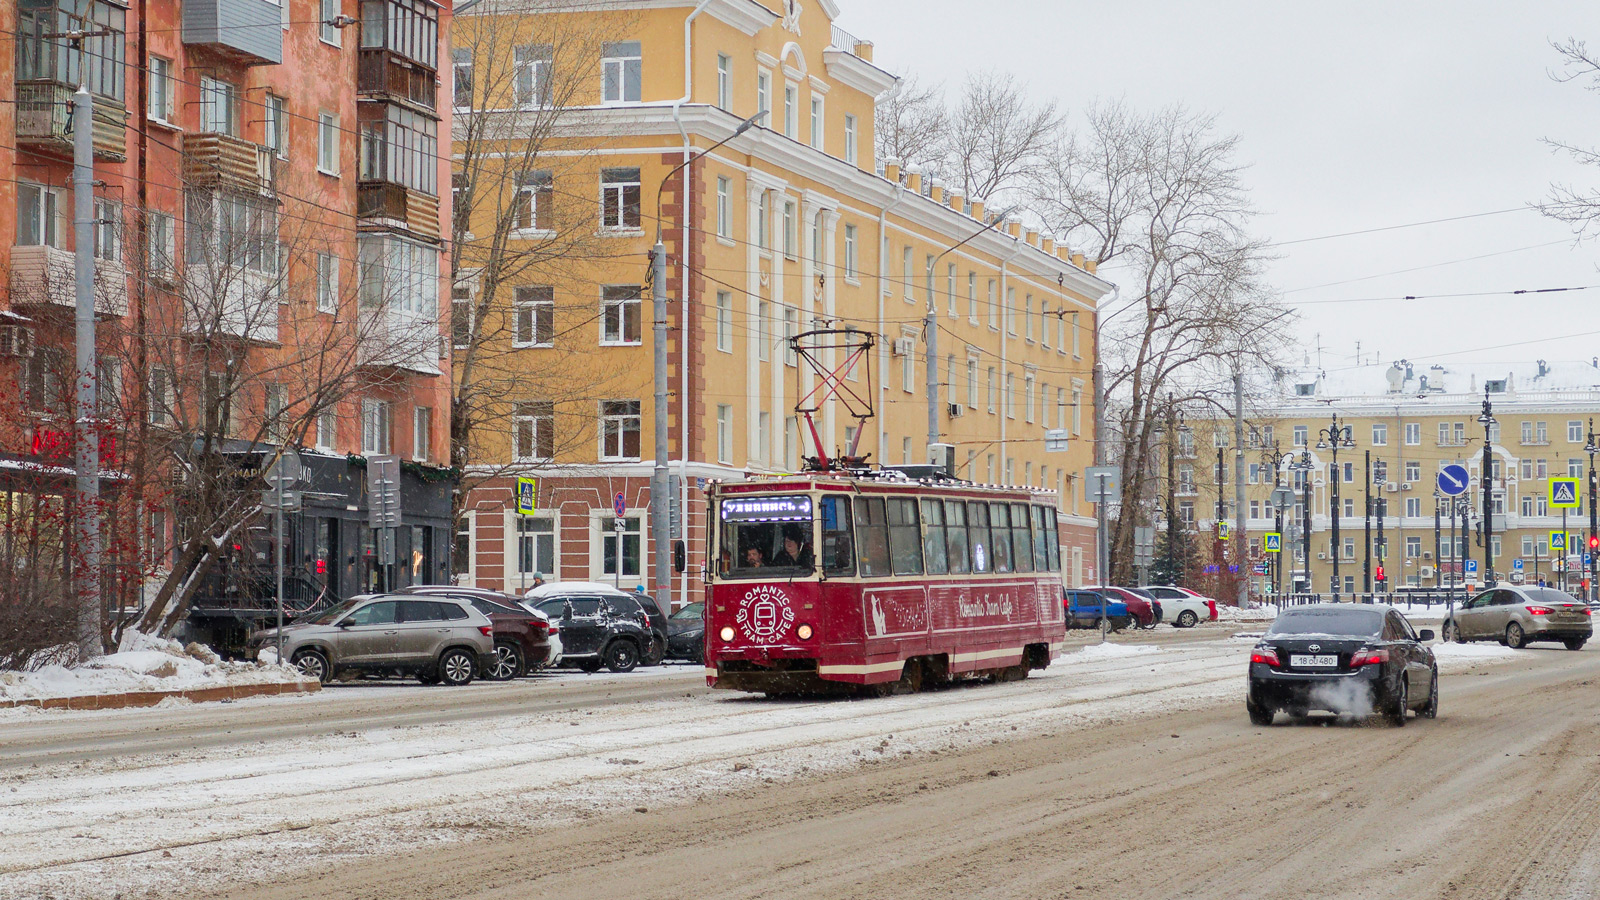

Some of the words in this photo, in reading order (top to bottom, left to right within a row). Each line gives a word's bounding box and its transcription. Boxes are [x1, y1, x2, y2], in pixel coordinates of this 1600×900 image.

[740, 585, 790, 606] ROMANTIC
[740, 623, 764, 644] TRAM
[768, 622, 791, 643] CAFE
[1299, 657, 1307, 665] 18
[1319, 657, 1334, 665] 480
